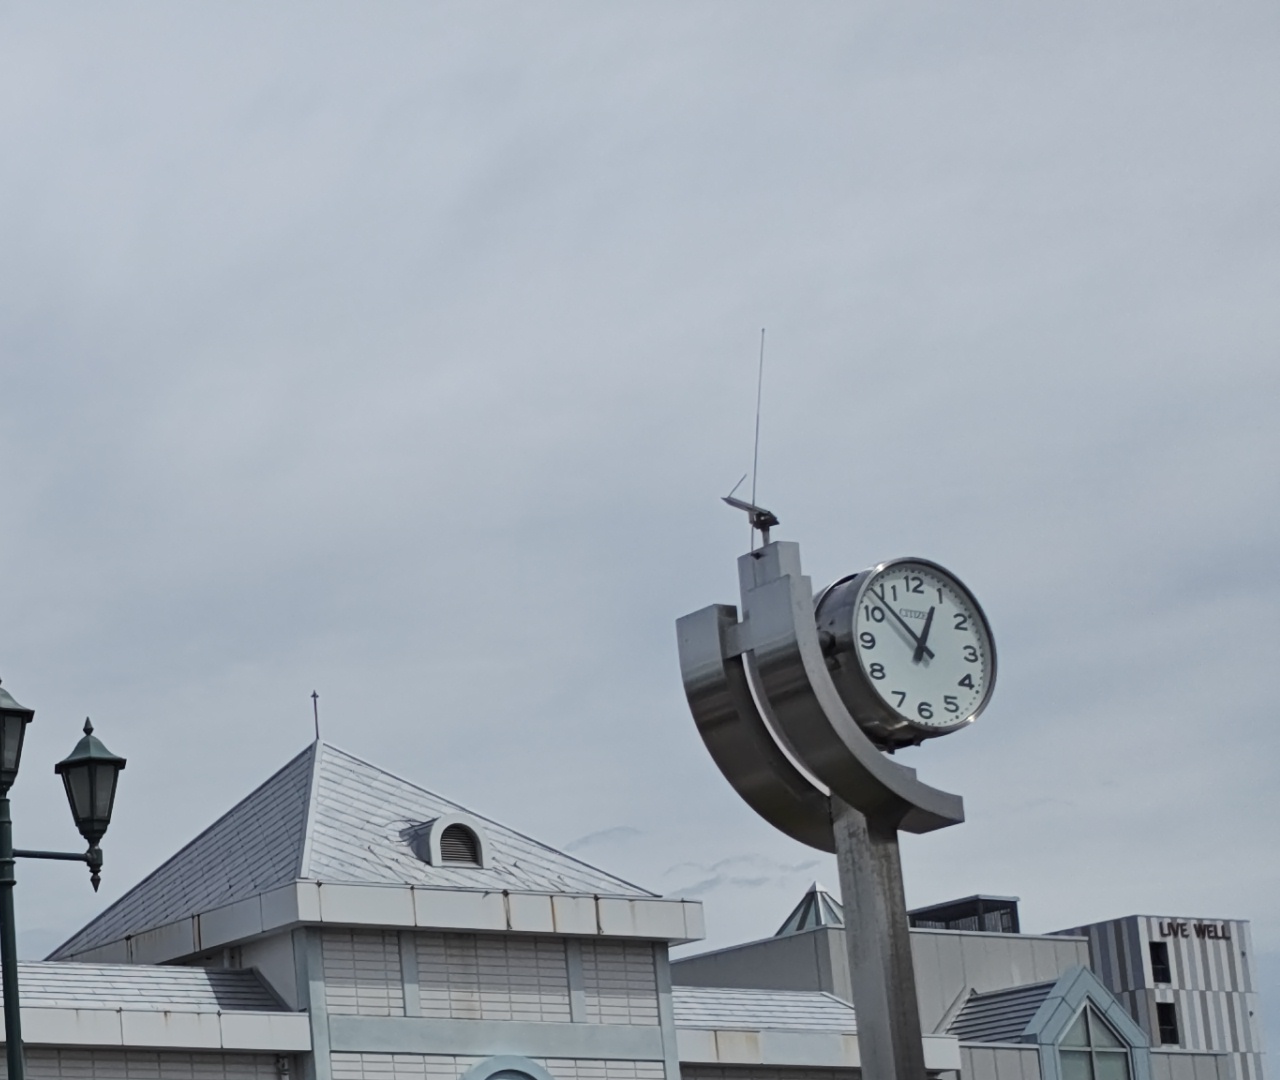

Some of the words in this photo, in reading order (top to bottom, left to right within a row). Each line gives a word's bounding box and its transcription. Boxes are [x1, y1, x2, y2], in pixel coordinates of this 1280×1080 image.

[903, 575, 925, 594] 12
[936, 588, 943, 604] 1
[864, 605, 885, 623] 10
[953, 613, 968, 631] 2
[859, 632, 876, 650] 9
[963, 645, 978, 663] 3
[869, 662, 886, 680] 8
[958, 673, 975, 690] 4
[891, 690, 906, 708] 7
[943, 695, 960, 713] 5
[917, 702, 934, 720] 6
[1159, 921, 1189, 938] LIVE
[1193, 923, 1231, 940] WELL
